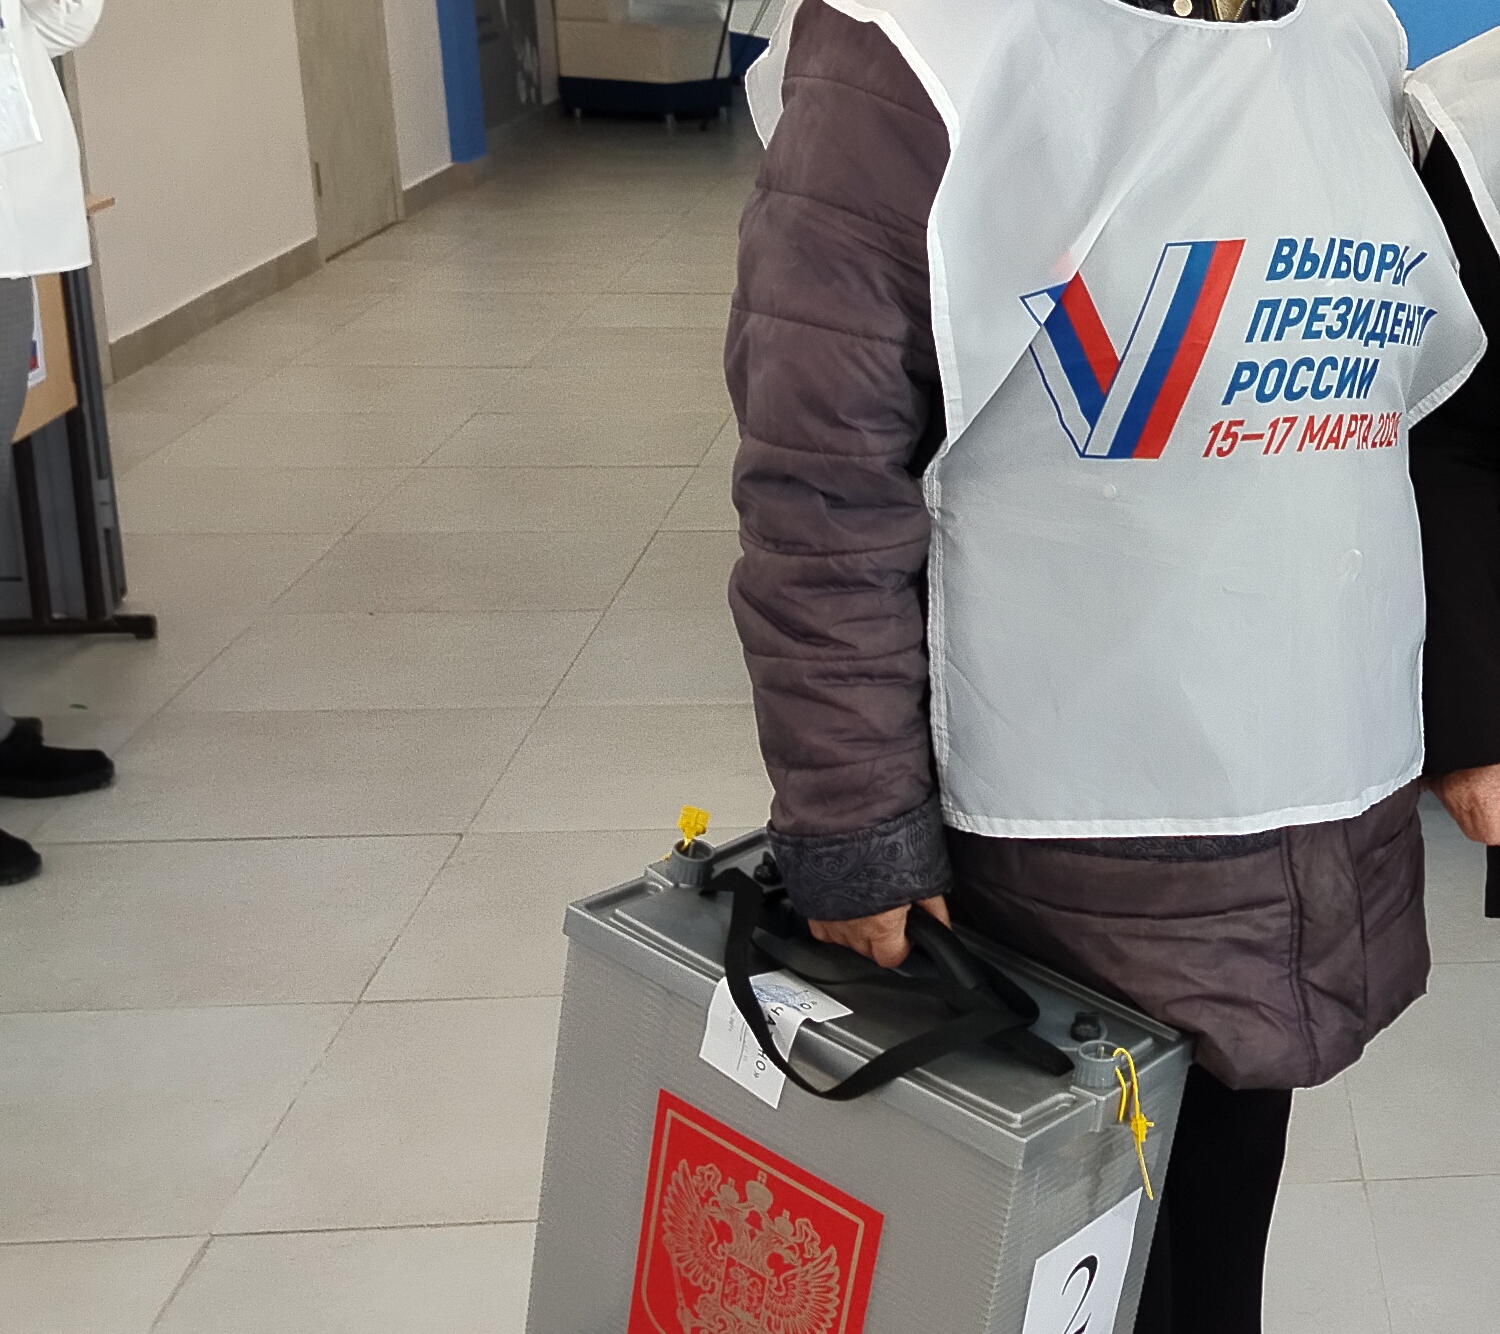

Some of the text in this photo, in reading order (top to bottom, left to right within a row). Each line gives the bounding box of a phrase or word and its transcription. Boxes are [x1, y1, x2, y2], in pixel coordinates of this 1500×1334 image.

[1265, 238, 1428, 287] ВЫБОРЫ
[1221, 356, 1380, 406] РОССИИ
[1297, 413, 1373, 452] МАРТА
